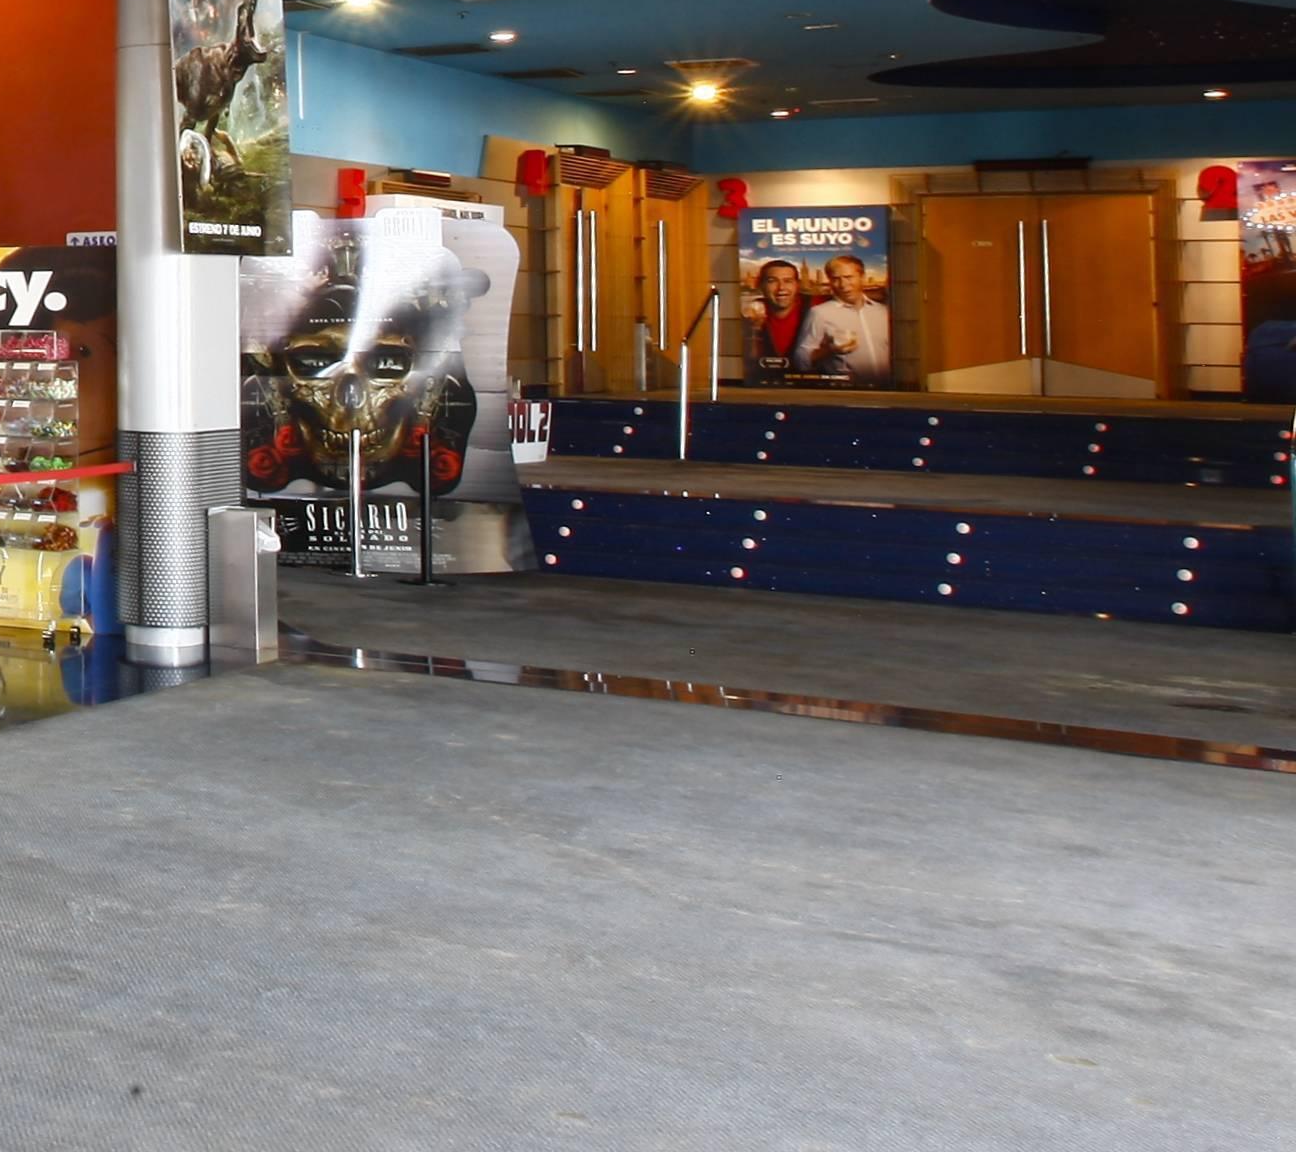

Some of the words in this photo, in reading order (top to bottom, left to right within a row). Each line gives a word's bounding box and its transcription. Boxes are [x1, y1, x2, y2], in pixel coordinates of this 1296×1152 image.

[718, 178, 748, 220] 3
[1197, 165, 1238, 221] 2
[189, 222, 222, 235] ESTRENO
[229, 224, 240, 236] DE
[240, 225, 262, 238] JUNIO
[751, 218, 781, 233] EL
[785, 216, 873, 233] MUNDO
[771, 233, 797, 246] ES
[800, 232, 853, 246] SUYO
[306, 501, 408, 532] SICRIO
